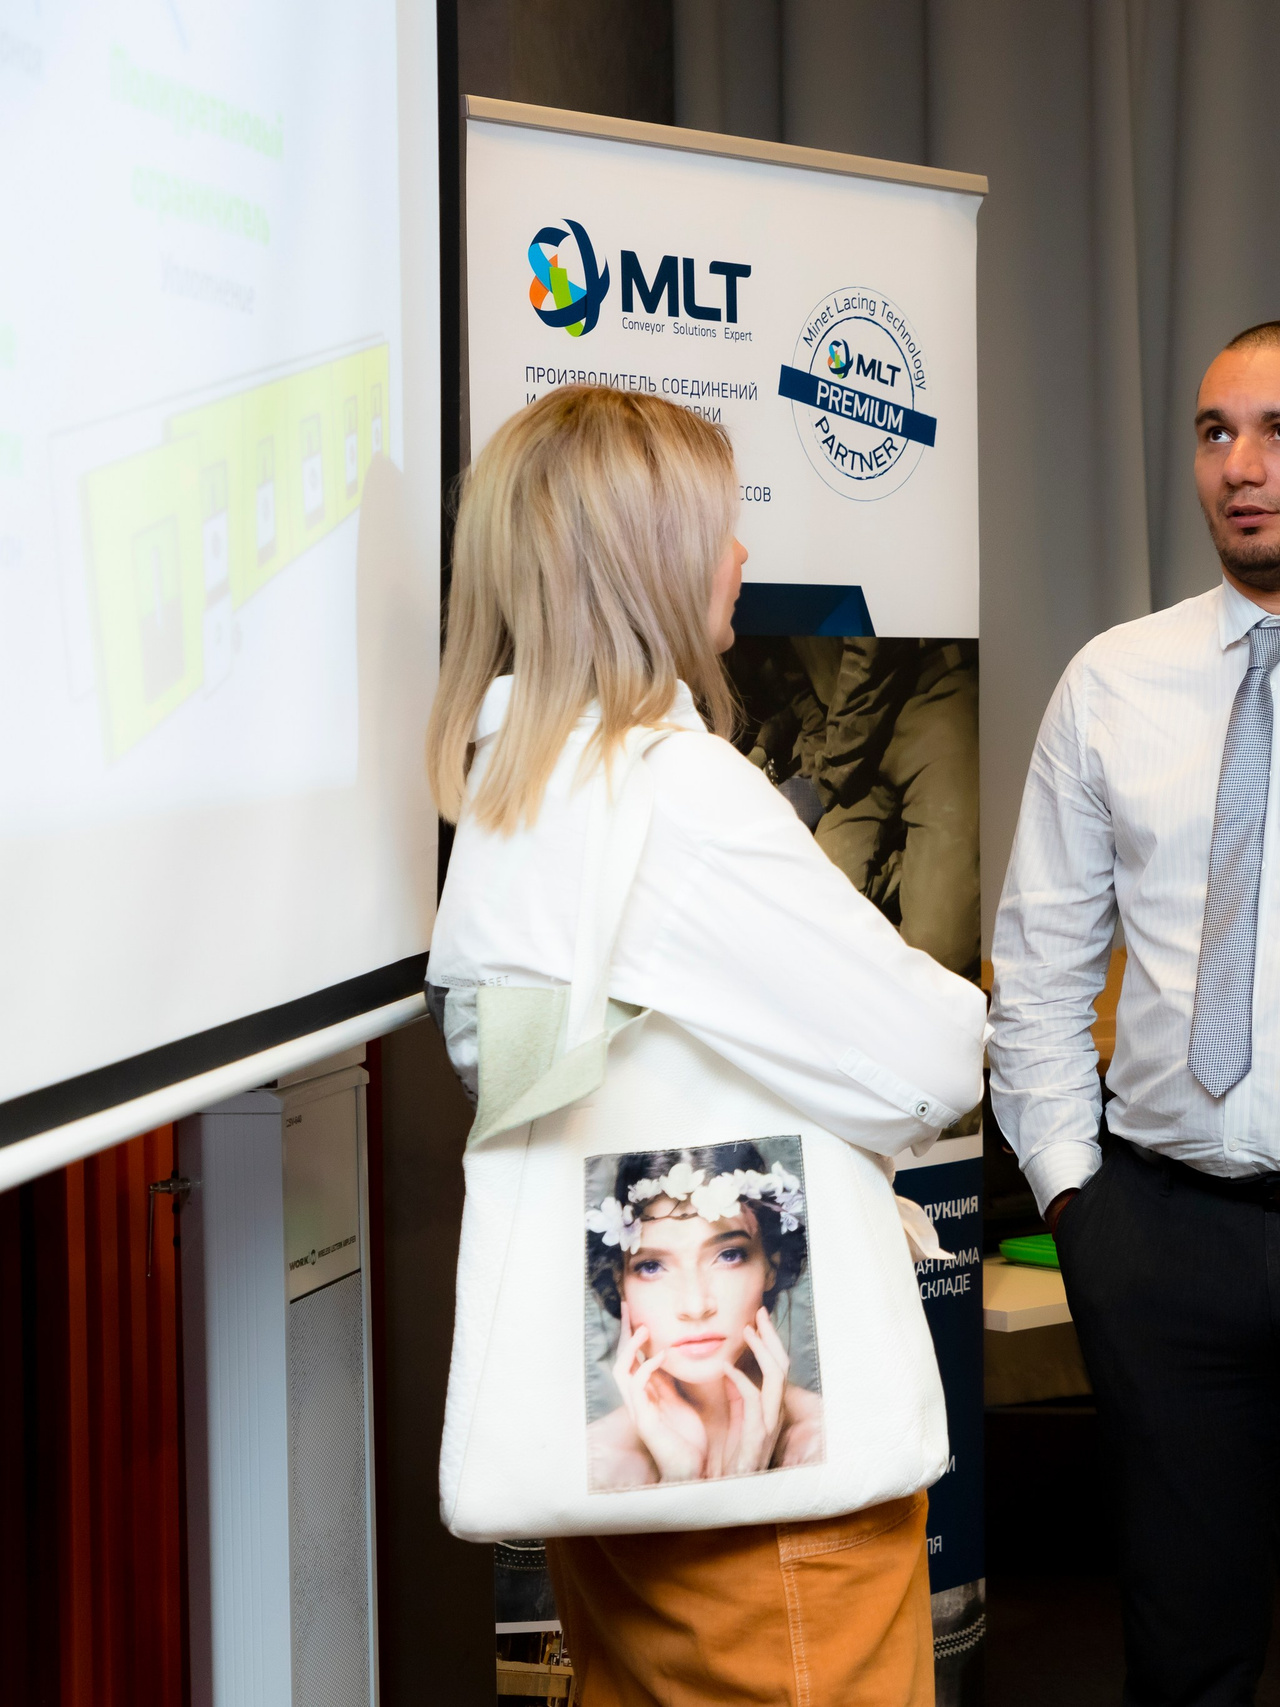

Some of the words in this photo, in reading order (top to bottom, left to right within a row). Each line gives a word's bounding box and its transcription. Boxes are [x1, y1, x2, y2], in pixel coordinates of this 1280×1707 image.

[620, 249, 752, 324] MLT
[621, 316, 666, 335] Conveyor
[672, 321, 717, 338] Solutions
[724, 326, 753, 343] Expert
[802, 304, 834, 348] Minet
[833, 292, 876, 316] Lacing
[881, 300, 926, 390] Technology
[525, 365, 657, 393] ПРОИЗВОДИТЕЛЬ
[661, 377, 758, 401] СОЕДИНЕНИЙ
[855, 353, 902, 387] MLT
[816, 380, 904, 433] PREMIUM
[814, 415, 899, 473] PARTNER
[920, 1272, 972, 1300] СКЛАДЕ
